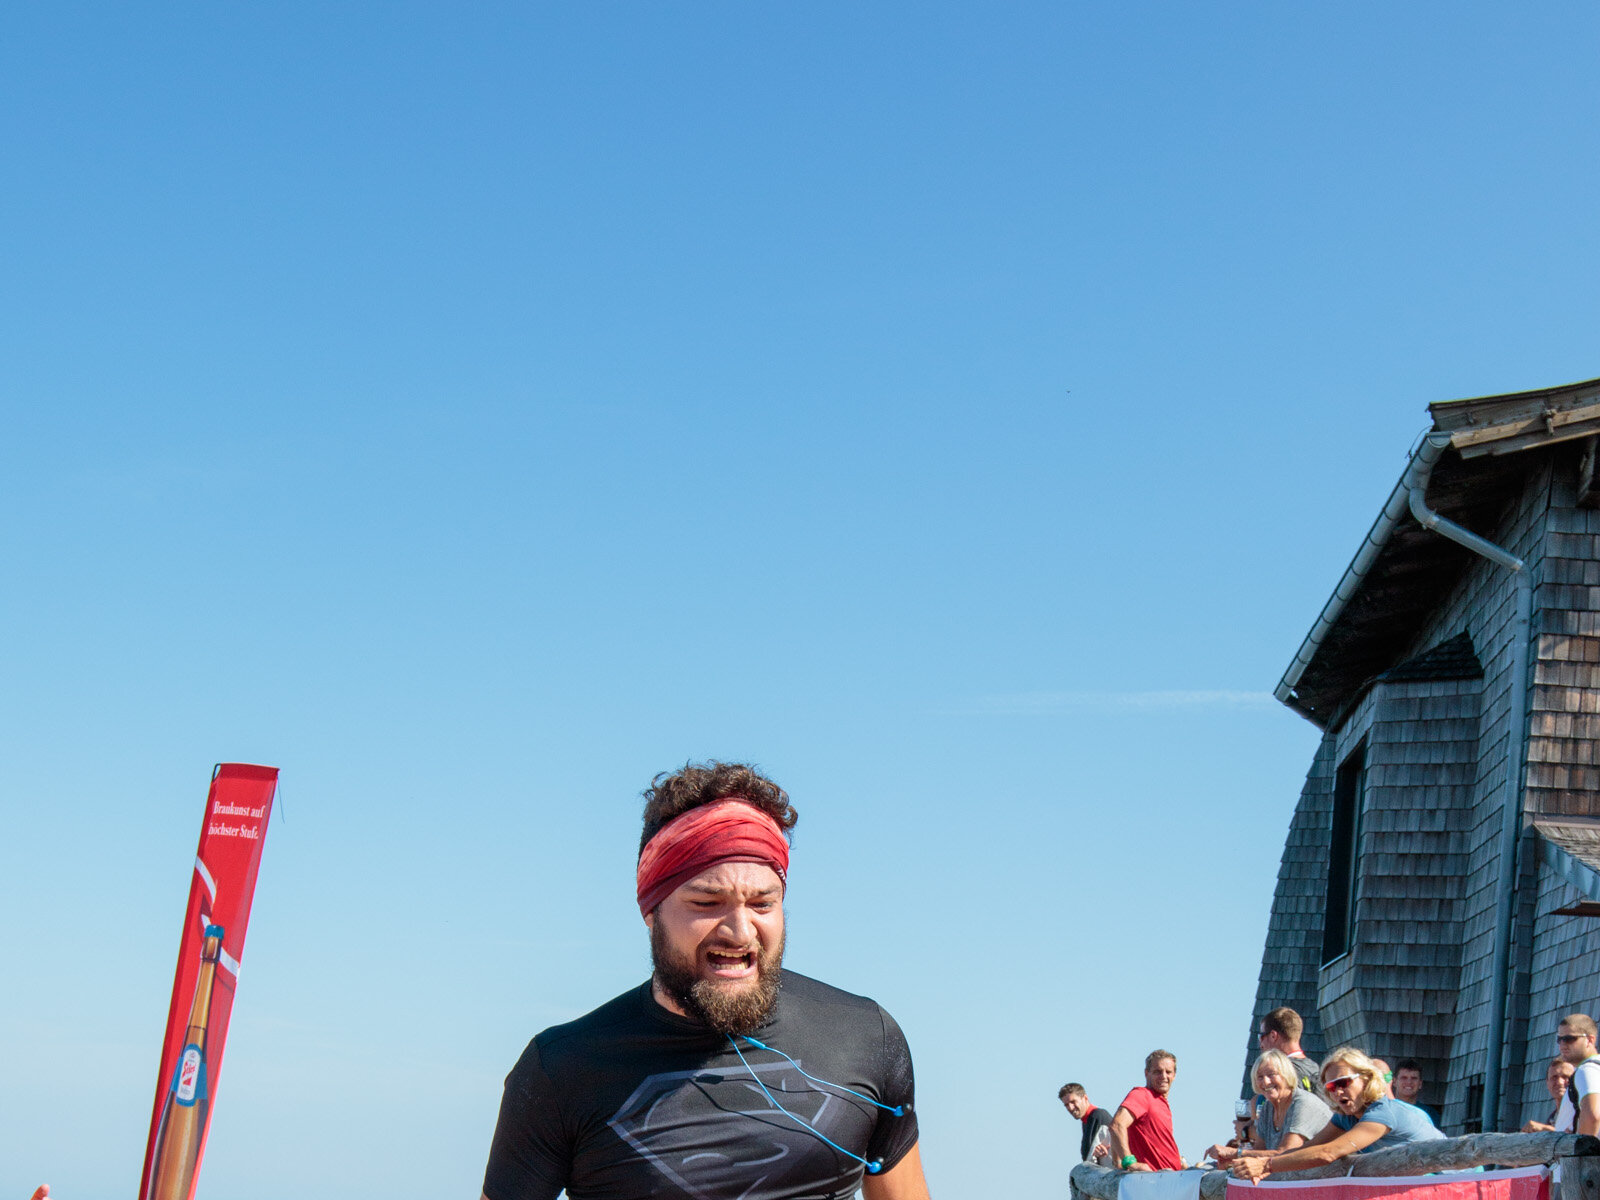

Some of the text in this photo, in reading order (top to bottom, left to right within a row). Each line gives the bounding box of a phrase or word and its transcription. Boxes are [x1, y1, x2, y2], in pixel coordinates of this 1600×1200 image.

[213, 801, 265, 818] Braukunst auf
[208, 822, 240, 837] höchster
